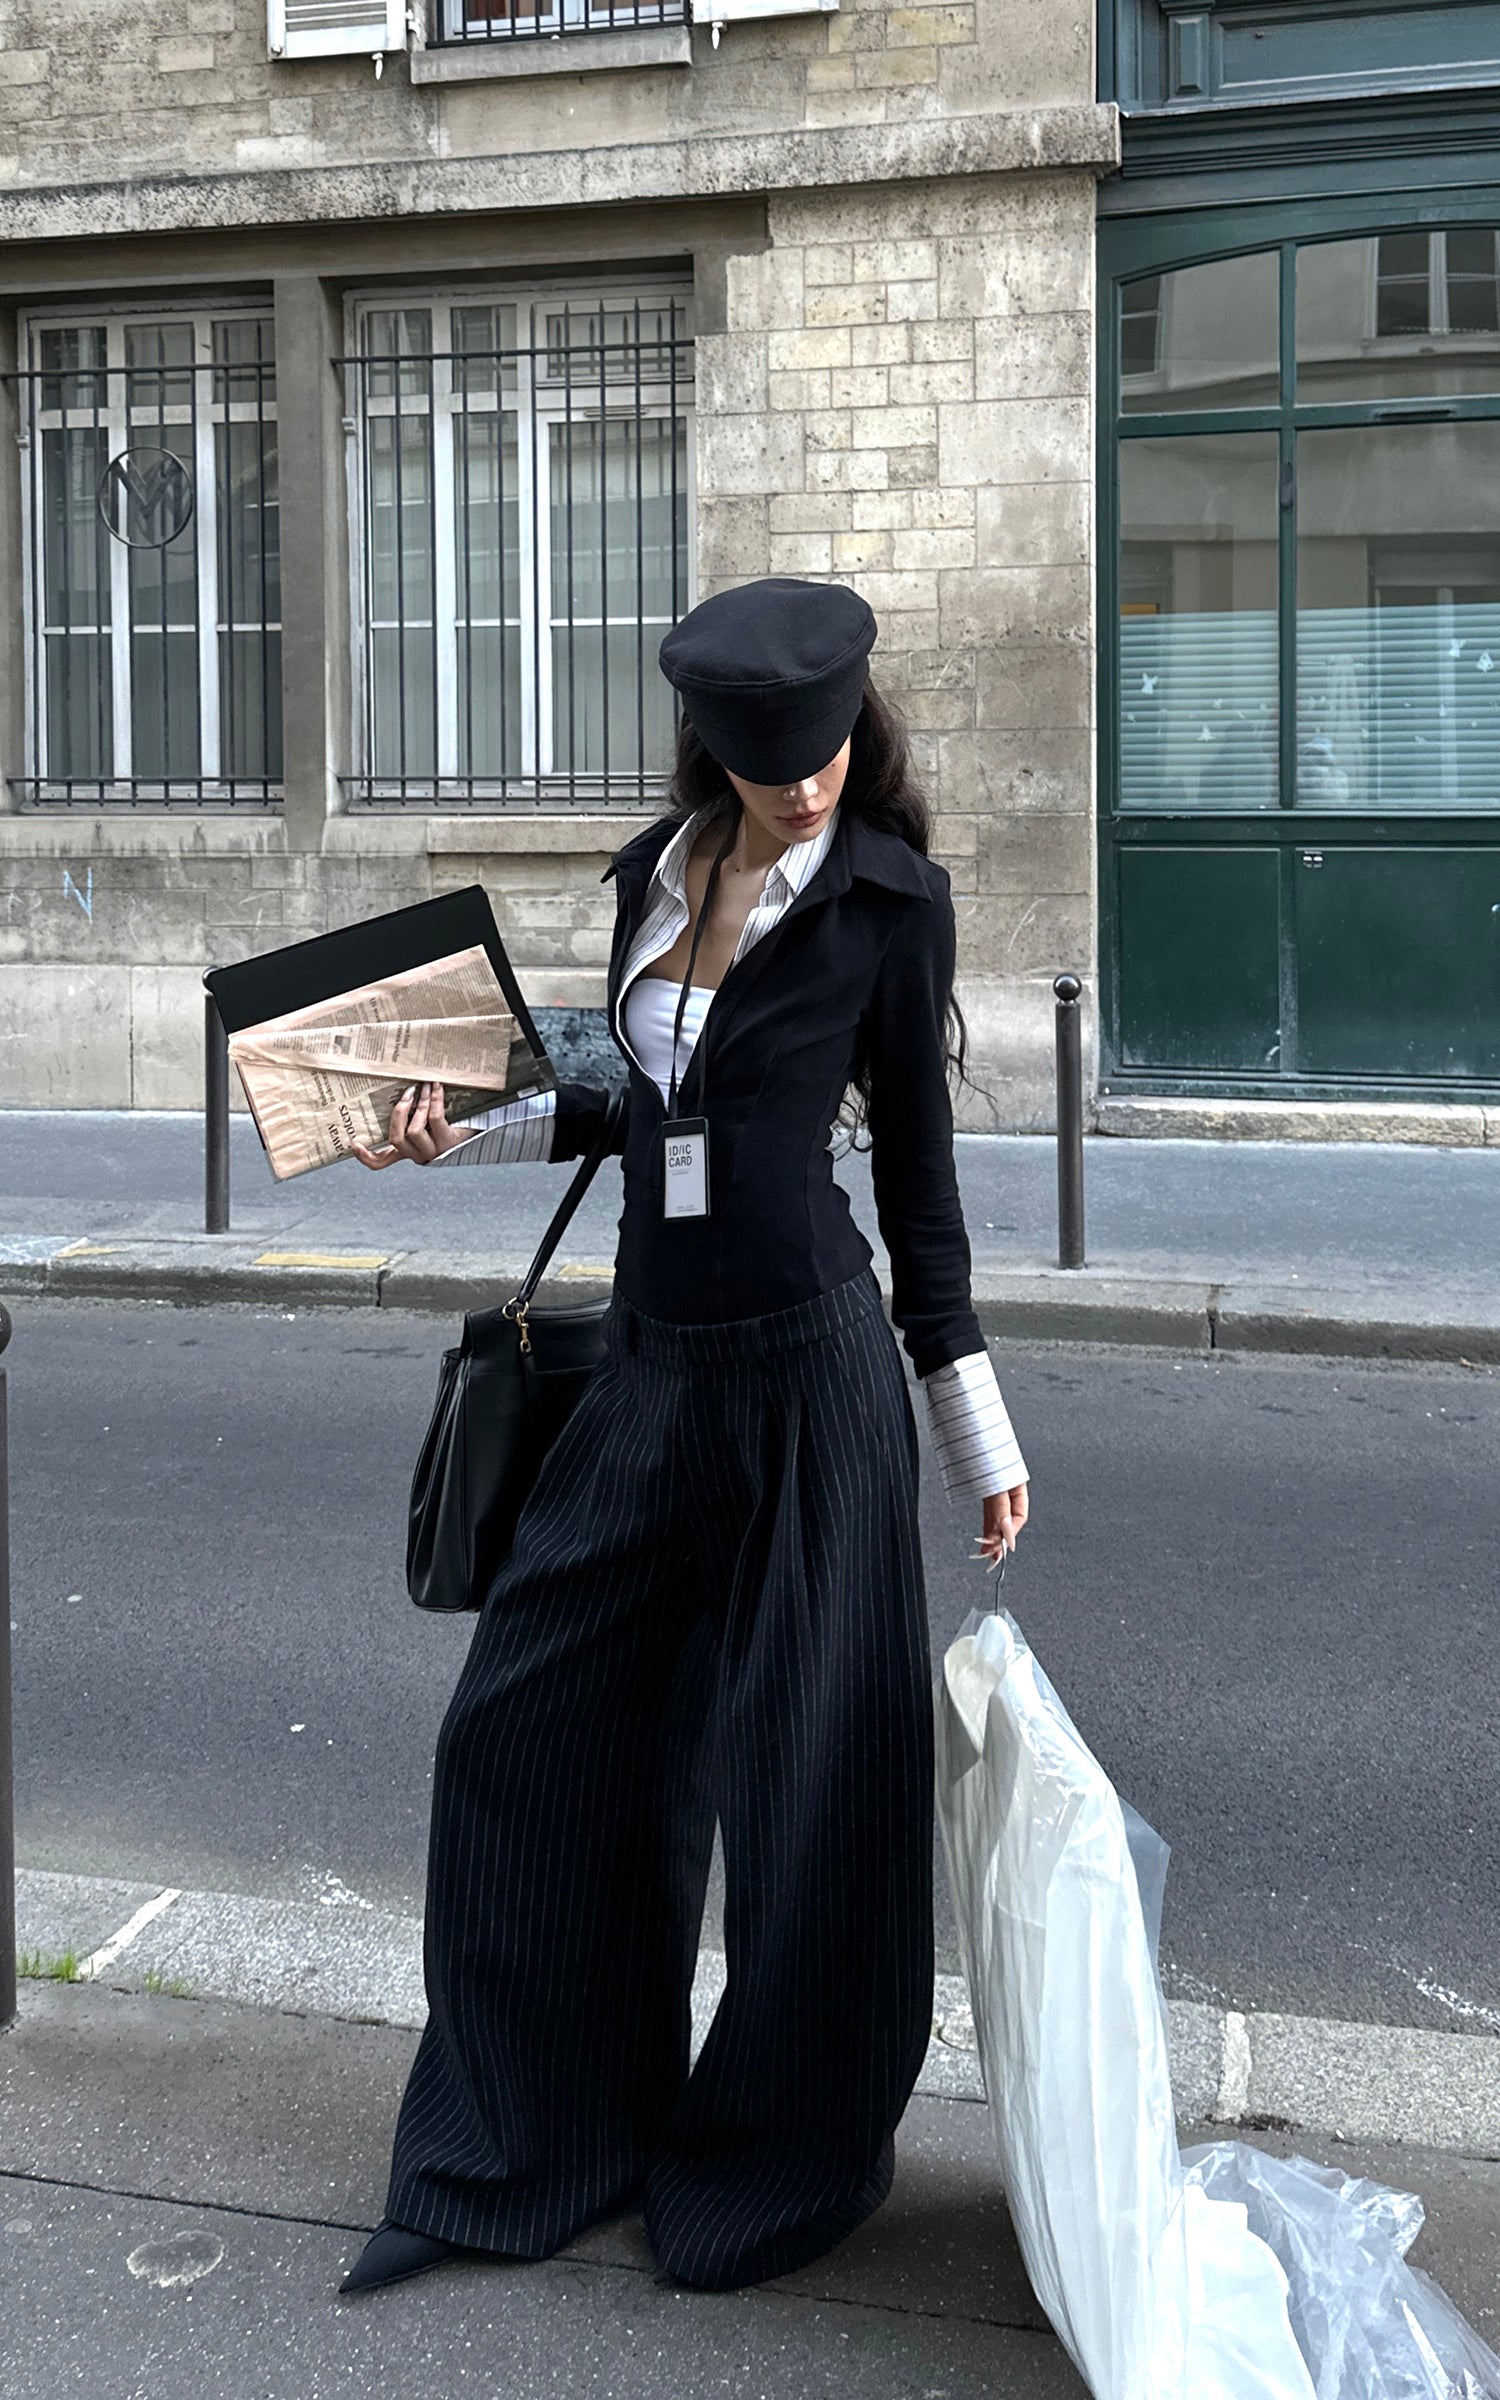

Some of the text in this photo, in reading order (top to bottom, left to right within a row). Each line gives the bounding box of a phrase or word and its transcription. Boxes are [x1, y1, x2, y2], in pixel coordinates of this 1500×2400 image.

[339, 1104, 357, 1139] voters
[327, 1123, 345, 1152] away
[668, 1144, 692, 1156] ID/IC
[668, 1156, 693, 1168] CARD
